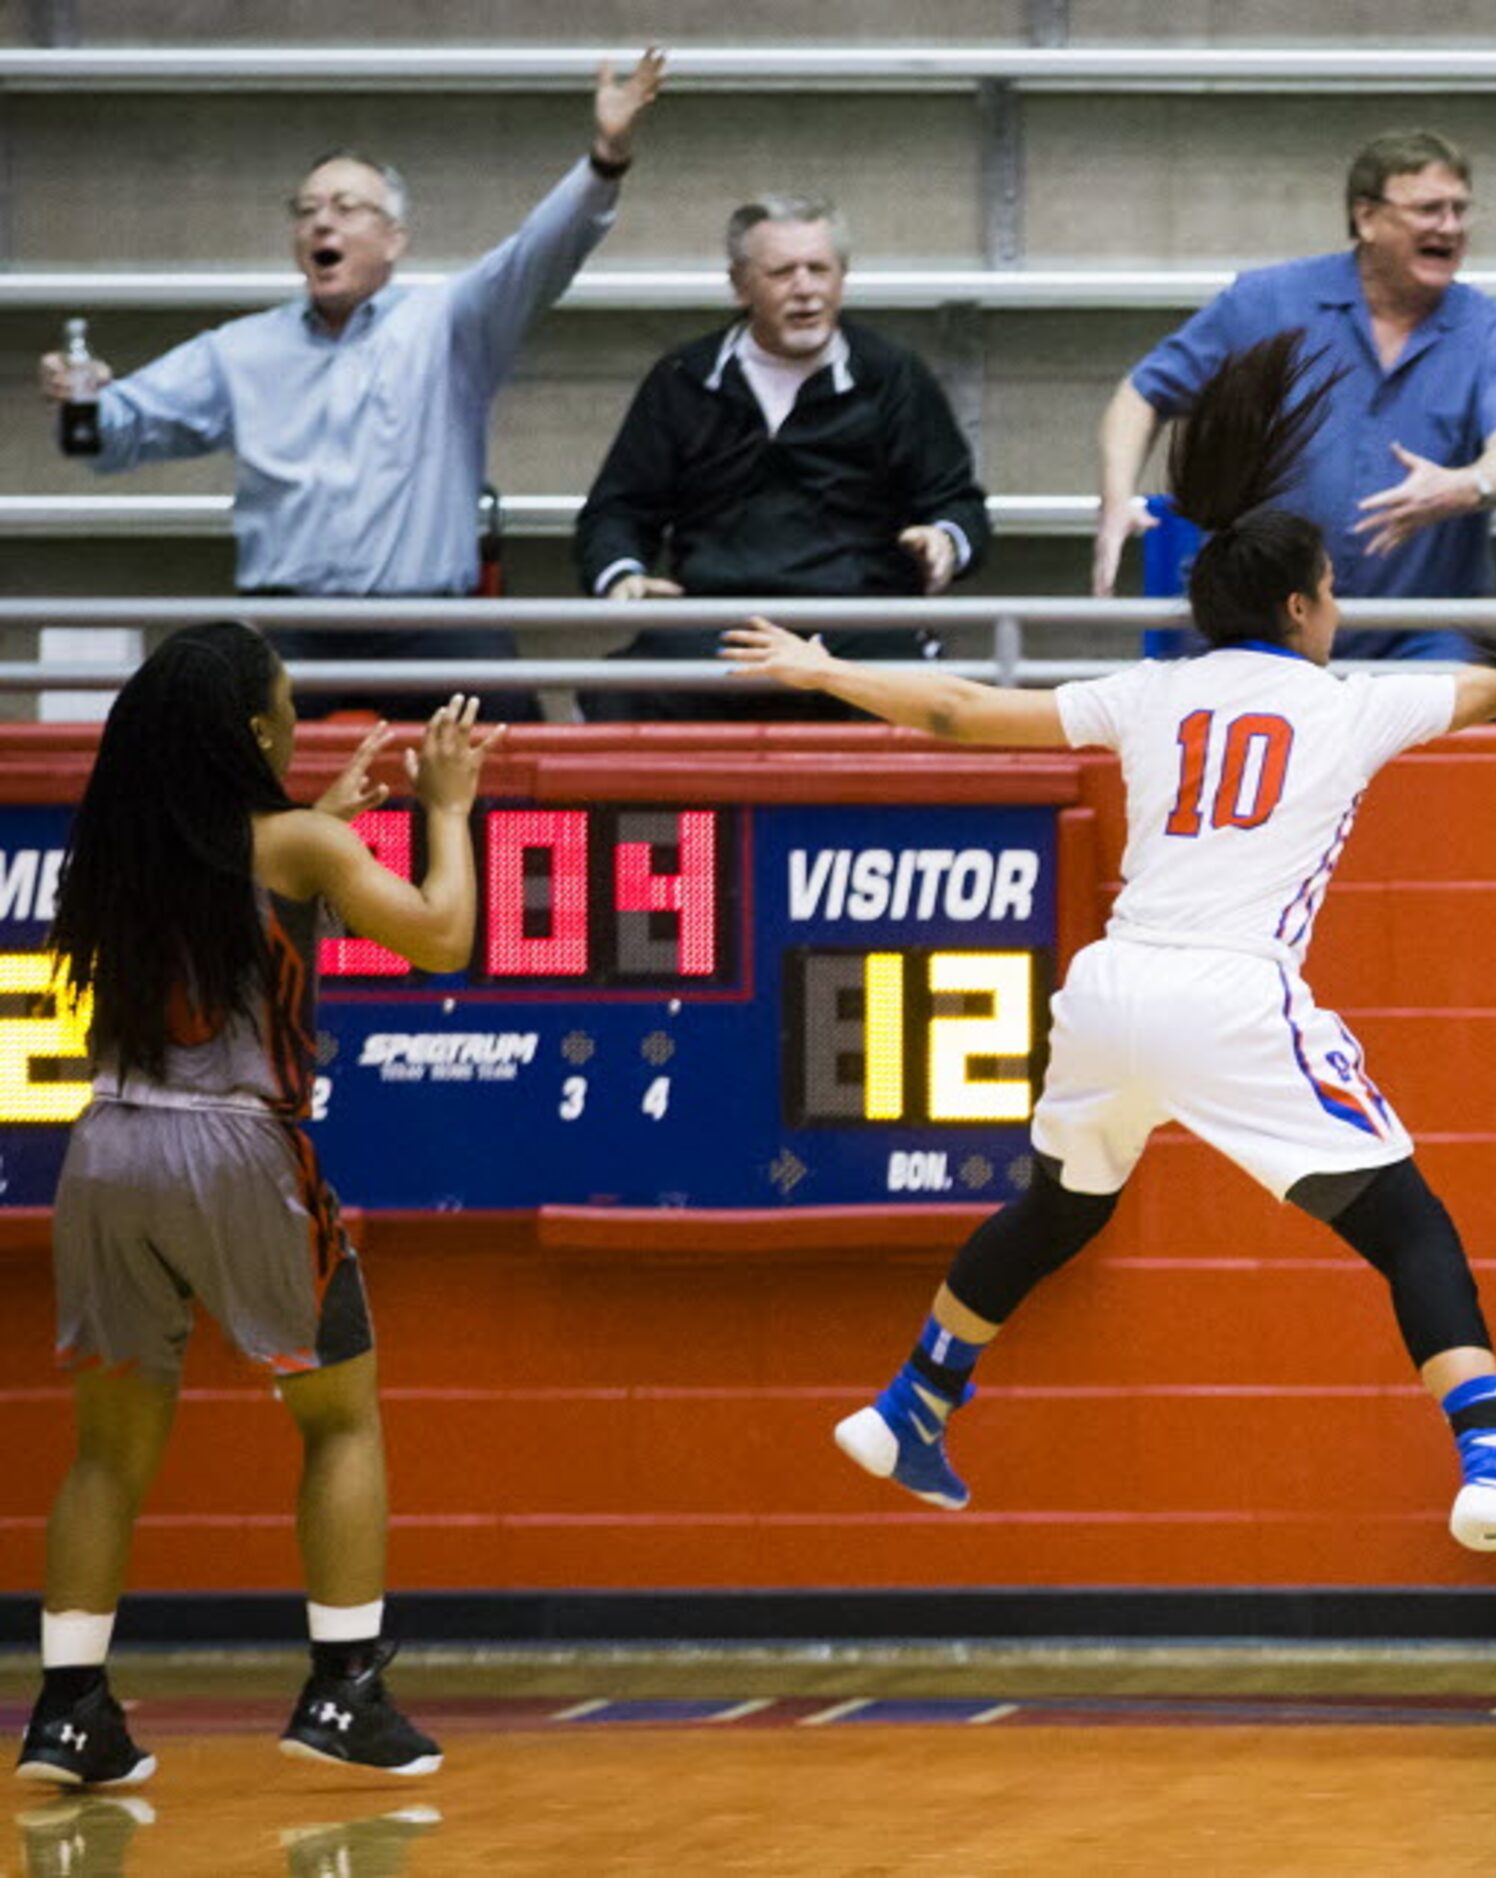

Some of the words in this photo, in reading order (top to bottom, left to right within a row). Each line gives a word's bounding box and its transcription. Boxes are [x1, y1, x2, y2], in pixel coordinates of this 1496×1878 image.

[1165, 709, 1295, 837] 10
[788, 849, 1040, 921] VISITOR
[863, 951, 1032, 1122] 12
[559, 1076, 588, 1120] 3
[641, 1076, 671, 1121] 4
